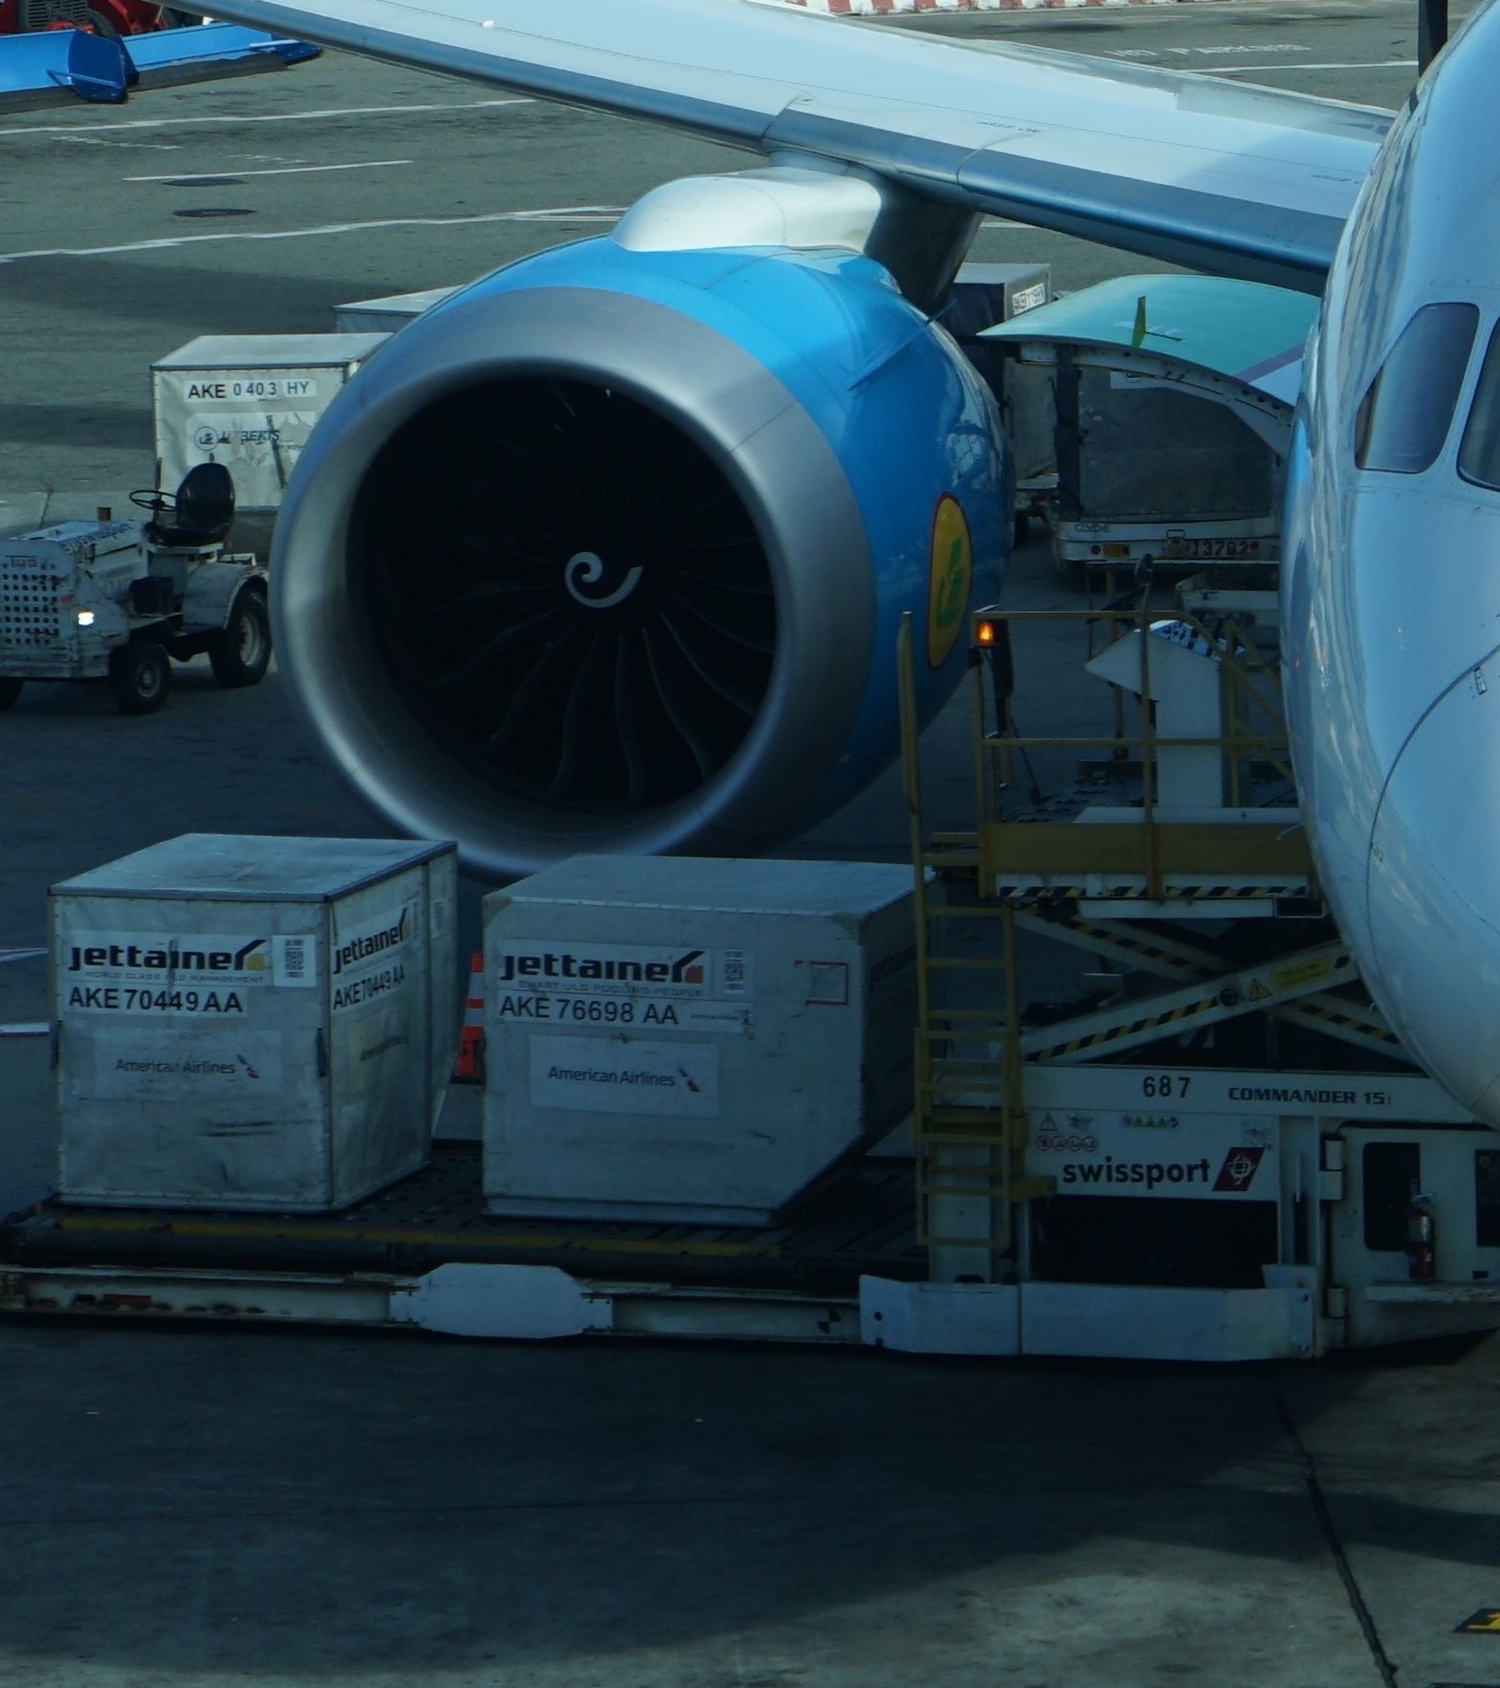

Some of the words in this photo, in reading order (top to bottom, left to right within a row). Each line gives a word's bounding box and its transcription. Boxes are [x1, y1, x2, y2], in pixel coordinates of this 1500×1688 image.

[188, 384, 226, 399] AKE
[287, 381, 309, 395] HY
[333, 907, 408, 974] jettainer
[68, 938, 267, 972] jettainer
[500, 950, 705, 984] jettainer
[125, 973, 161, 981] CLASS
[68, 986, 119, 1010] AKE
[124, 989, 199, 1012] 70449
[203, 991, 244, 1013] AA
[333, 985, 362, 1011] AKE
[500, 996, 550, 1019] AKE
[556, 999, 634, 1023] 76698
[643, 1003, 679, 1025] AA
[115, 1059, 180, 1075] American
[183, 1060, 236, 1075] Airlines
[548, 1066, 617, 1084] American
[620, 1069, 676, 1087] Airlines
[1143, 1075, 1192, 1099] 687
[1228, 1086, 1356, 1104] COMMANDER
[1062, 1155, 1211, 1189] swissport
